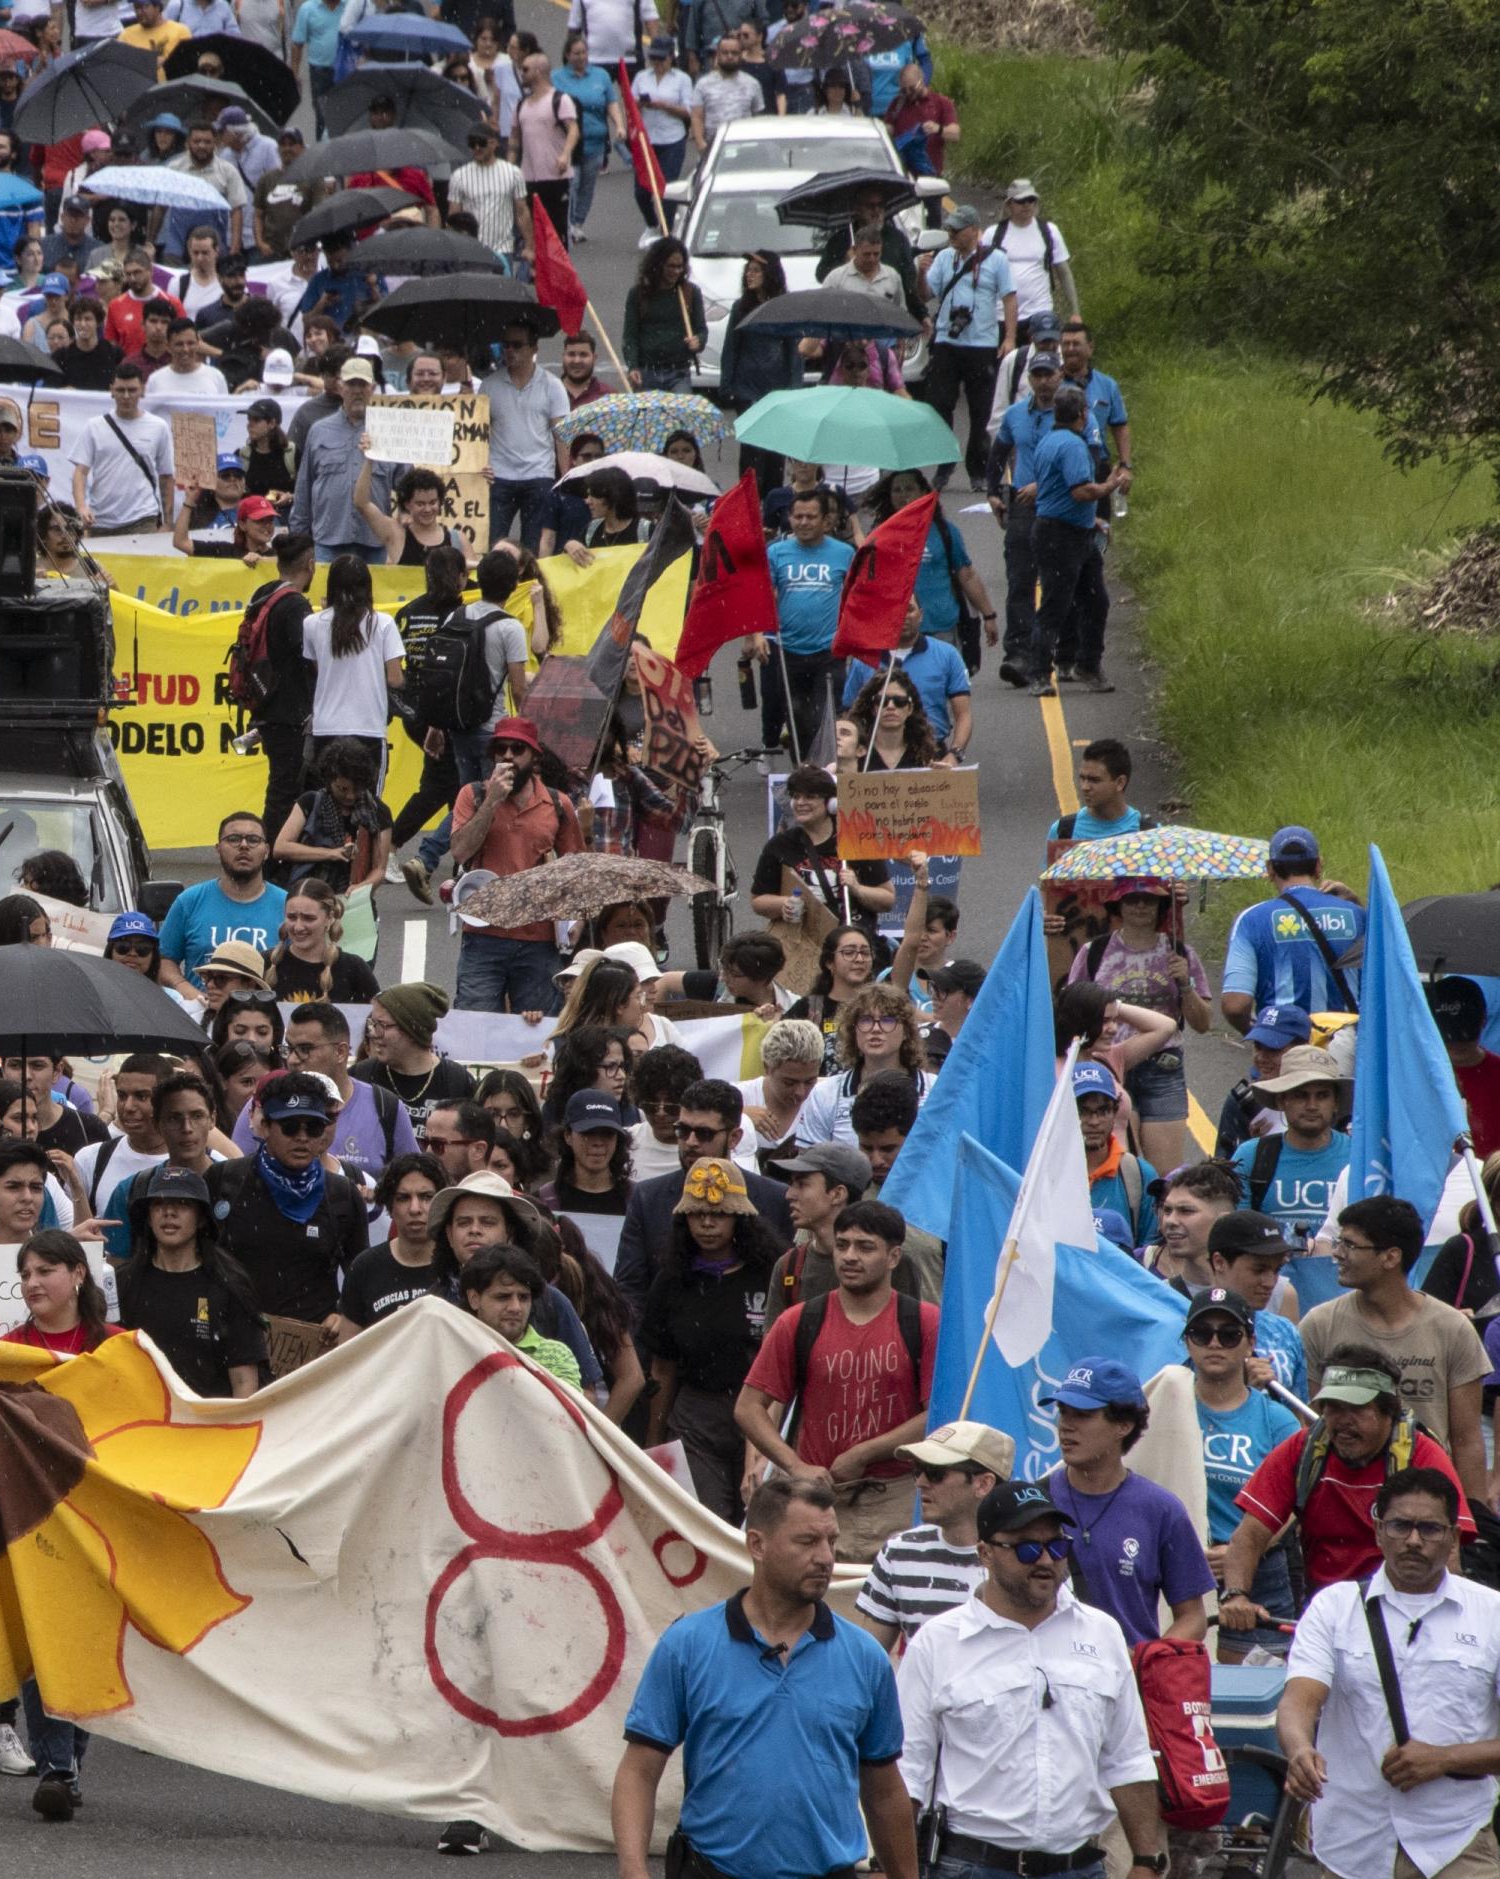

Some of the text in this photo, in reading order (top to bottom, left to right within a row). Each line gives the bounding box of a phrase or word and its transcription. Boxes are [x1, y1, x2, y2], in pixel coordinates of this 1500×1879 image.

[464, 501, 485, 518] EL
[786, 563, 832, 582] UCR
[110, 721, 205, 757] ODELO
[864, 786, 879, 797] no
[883, 780, 901, 797] hay
[865, 801, 886, 813] para
[890, 799, 900, 810] el
[875, 816, 890, 826] no
[211, 926, 268, 950] UCR
[1074, 1068, 1101, 1081] UCR
[373, 1289, 411, 1313] CIENCIAS
[825, 1341, 899, 1384] YOUNG
[1067, 1367, 1094, 1382] UCR
[841, 1380, 880, 1410] THE
[827, 1393, 899, 1443] GIANT
[1203, 1433, 1255, 1467] CR
[1072, 1640, 1099, 1656] UCR
[1455, 1632, 1479, 1646] UCR
